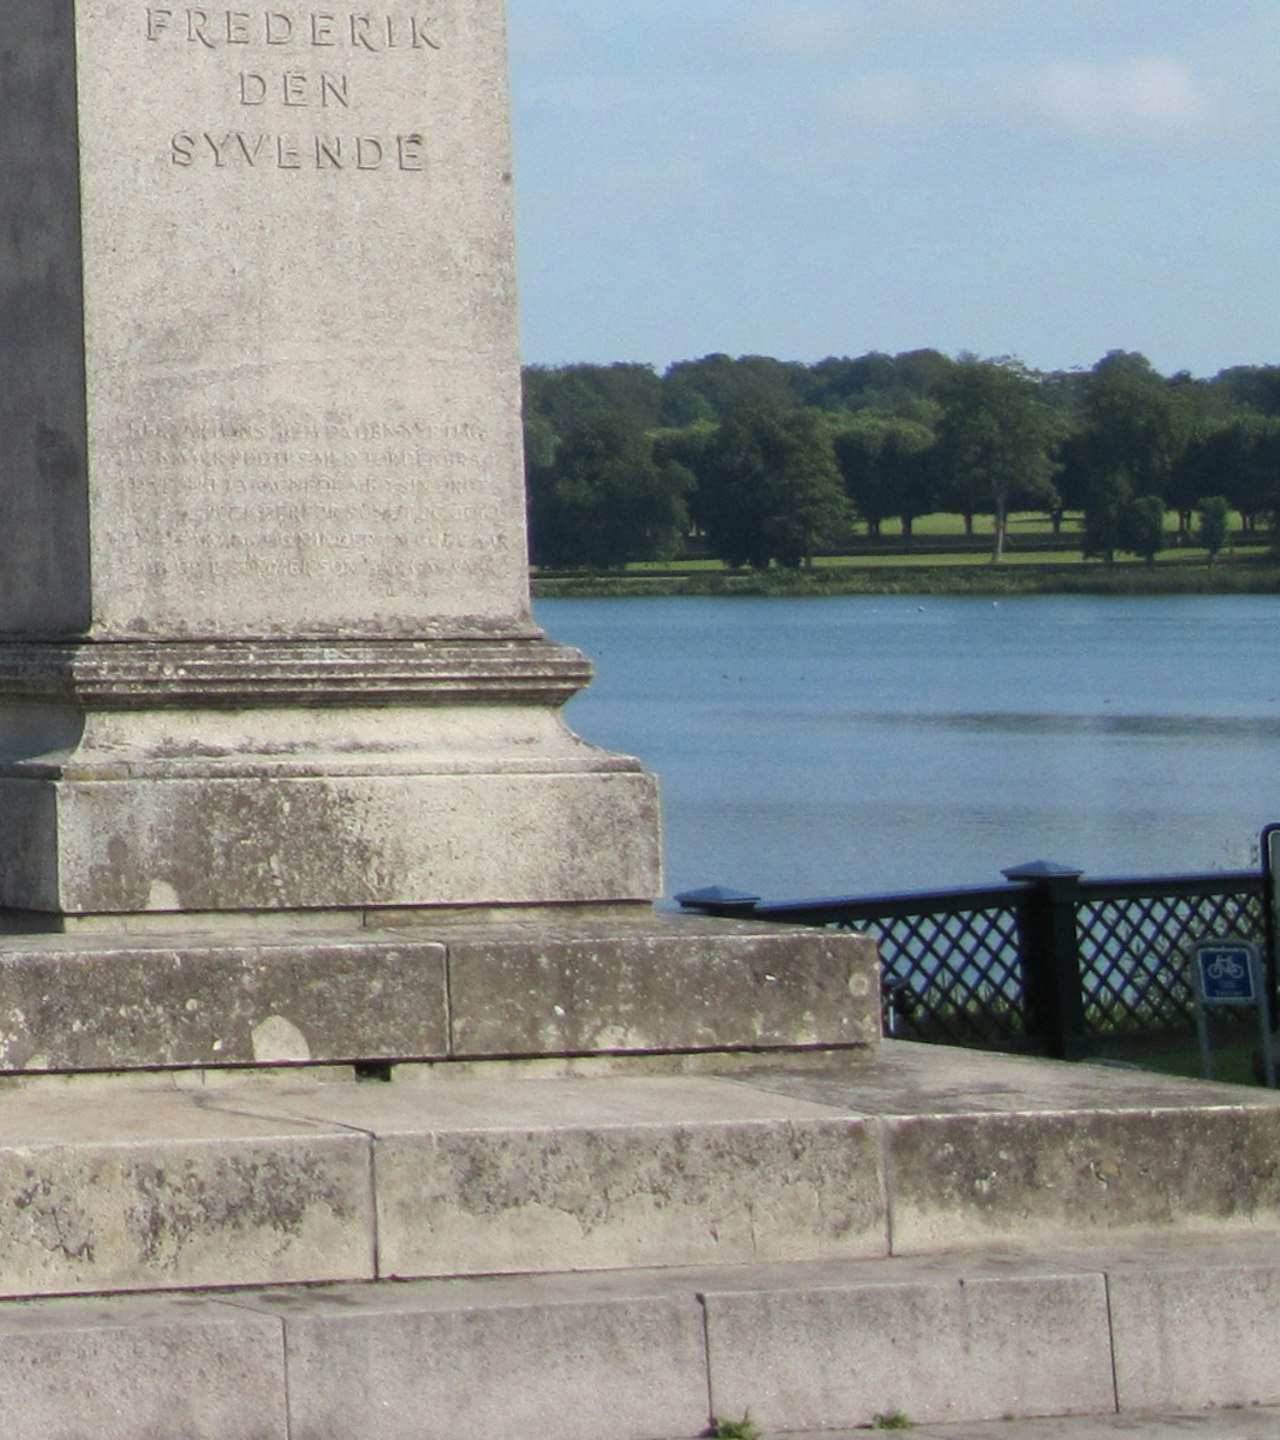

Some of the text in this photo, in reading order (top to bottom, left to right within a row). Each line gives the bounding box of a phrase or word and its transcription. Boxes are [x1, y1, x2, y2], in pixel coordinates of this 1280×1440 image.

[146, 9, 440, 52] FREDERIK
[240, 71, 348, 108] DEN
[171, 131, 423, 171] SYVENDE
